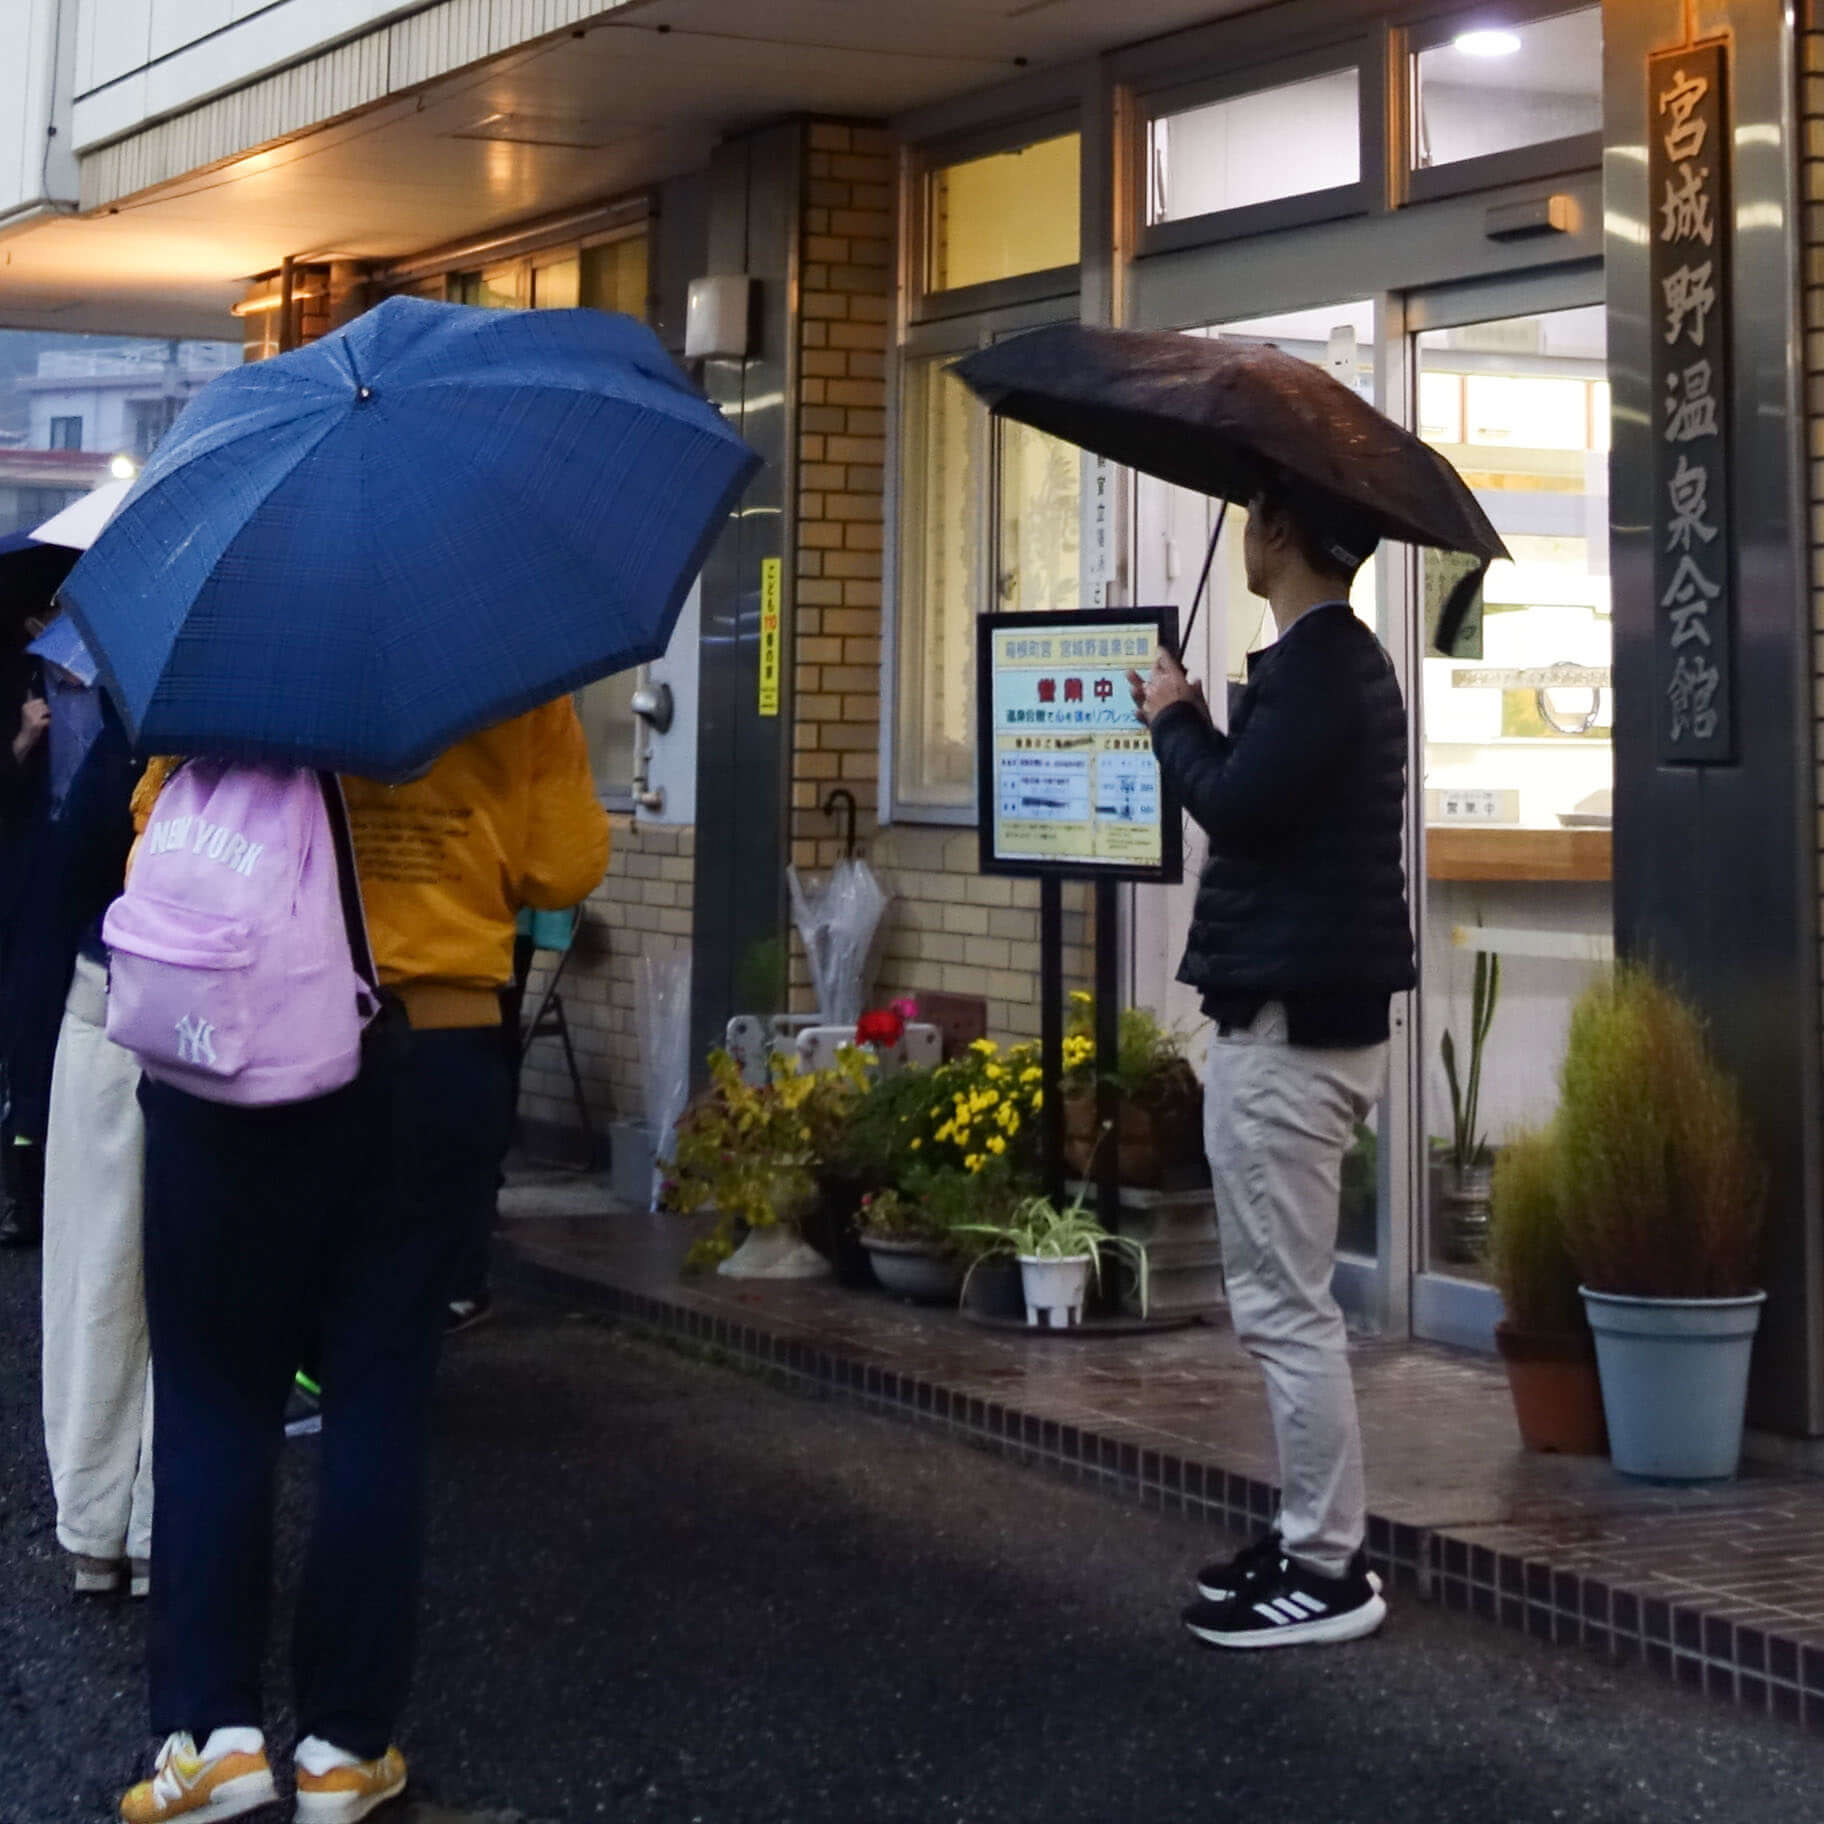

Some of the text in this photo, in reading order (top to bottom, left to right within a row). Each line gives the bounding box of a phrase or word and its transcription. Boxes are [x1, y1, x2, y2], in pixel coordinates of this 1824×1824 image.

[1659, 71, 1721, 740] 宮城野温泉会館
[150, 816, 265, 877] NEW YORK
